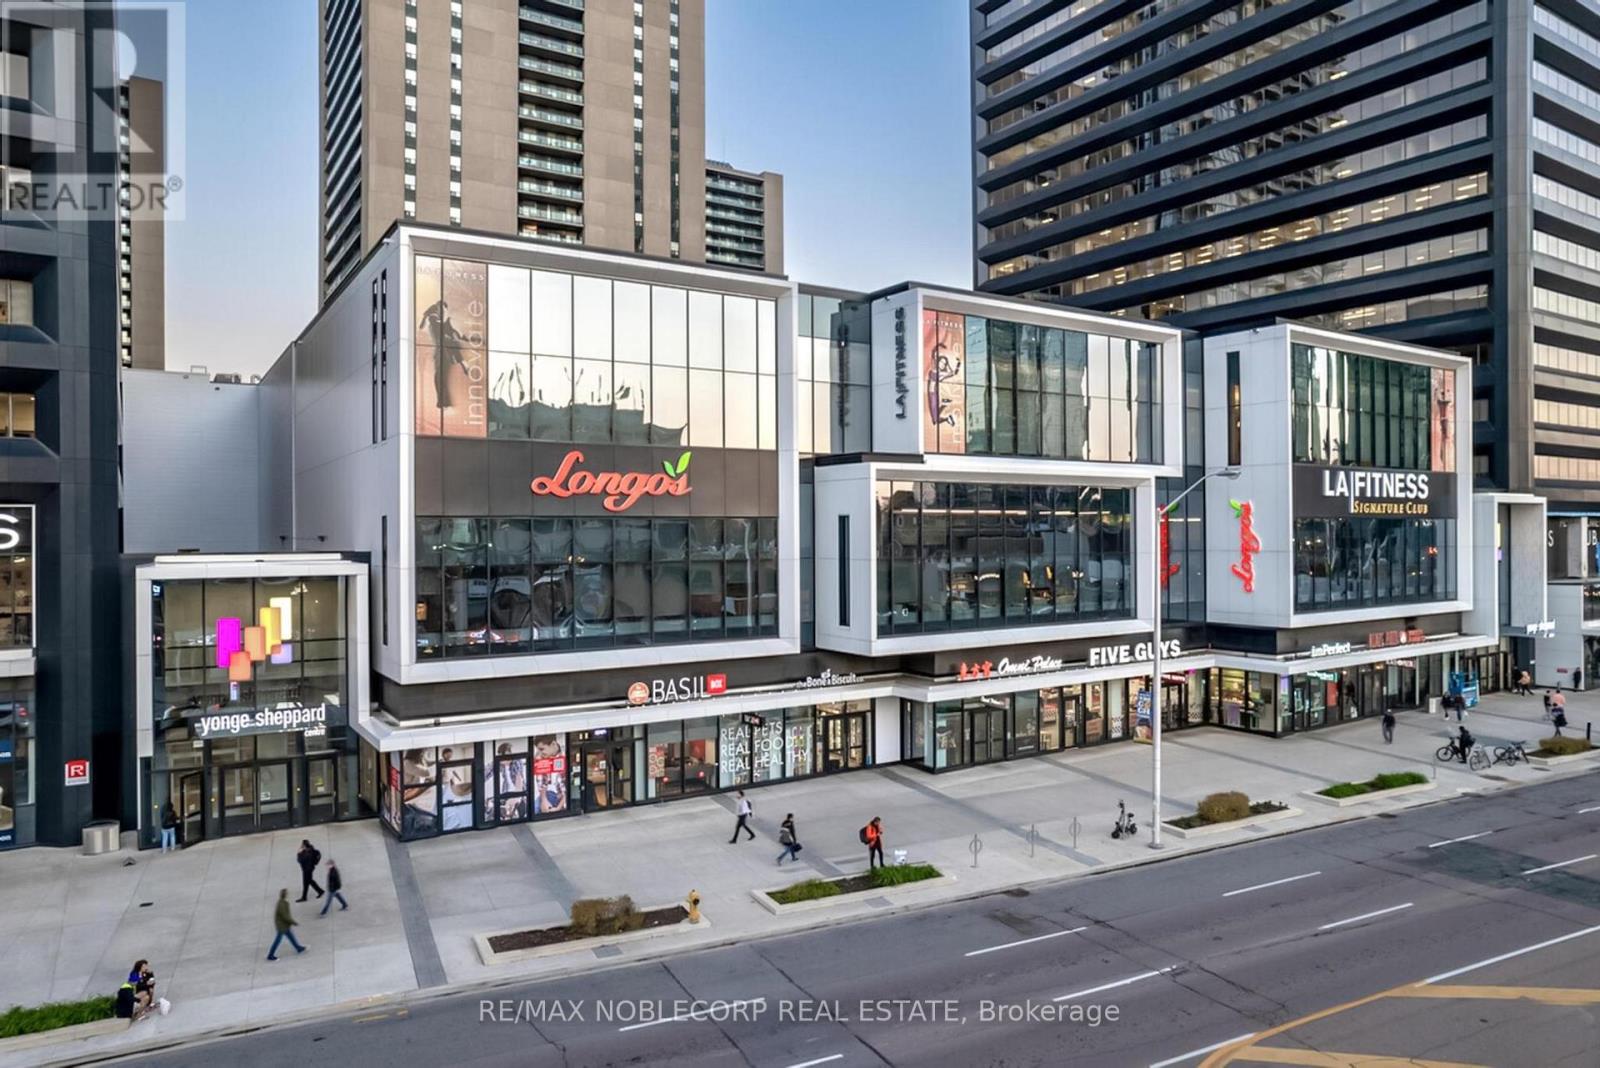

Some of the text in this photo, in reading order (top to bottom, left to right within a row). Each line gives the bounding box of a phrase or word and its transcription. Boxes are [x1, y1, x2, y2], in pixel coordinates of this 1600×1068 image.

[1355, 471, 1429, 500] FITNESS
[1089, 645, 1131, 667] FIVE
[652, 675, 712, 703] BASIL
[201, 701, 327, 737] yonge sheppard
[720, 725, 751, 741] REAL
[720, 740, 751, 757] REAL
[720, 756, 751, 774] REAL
